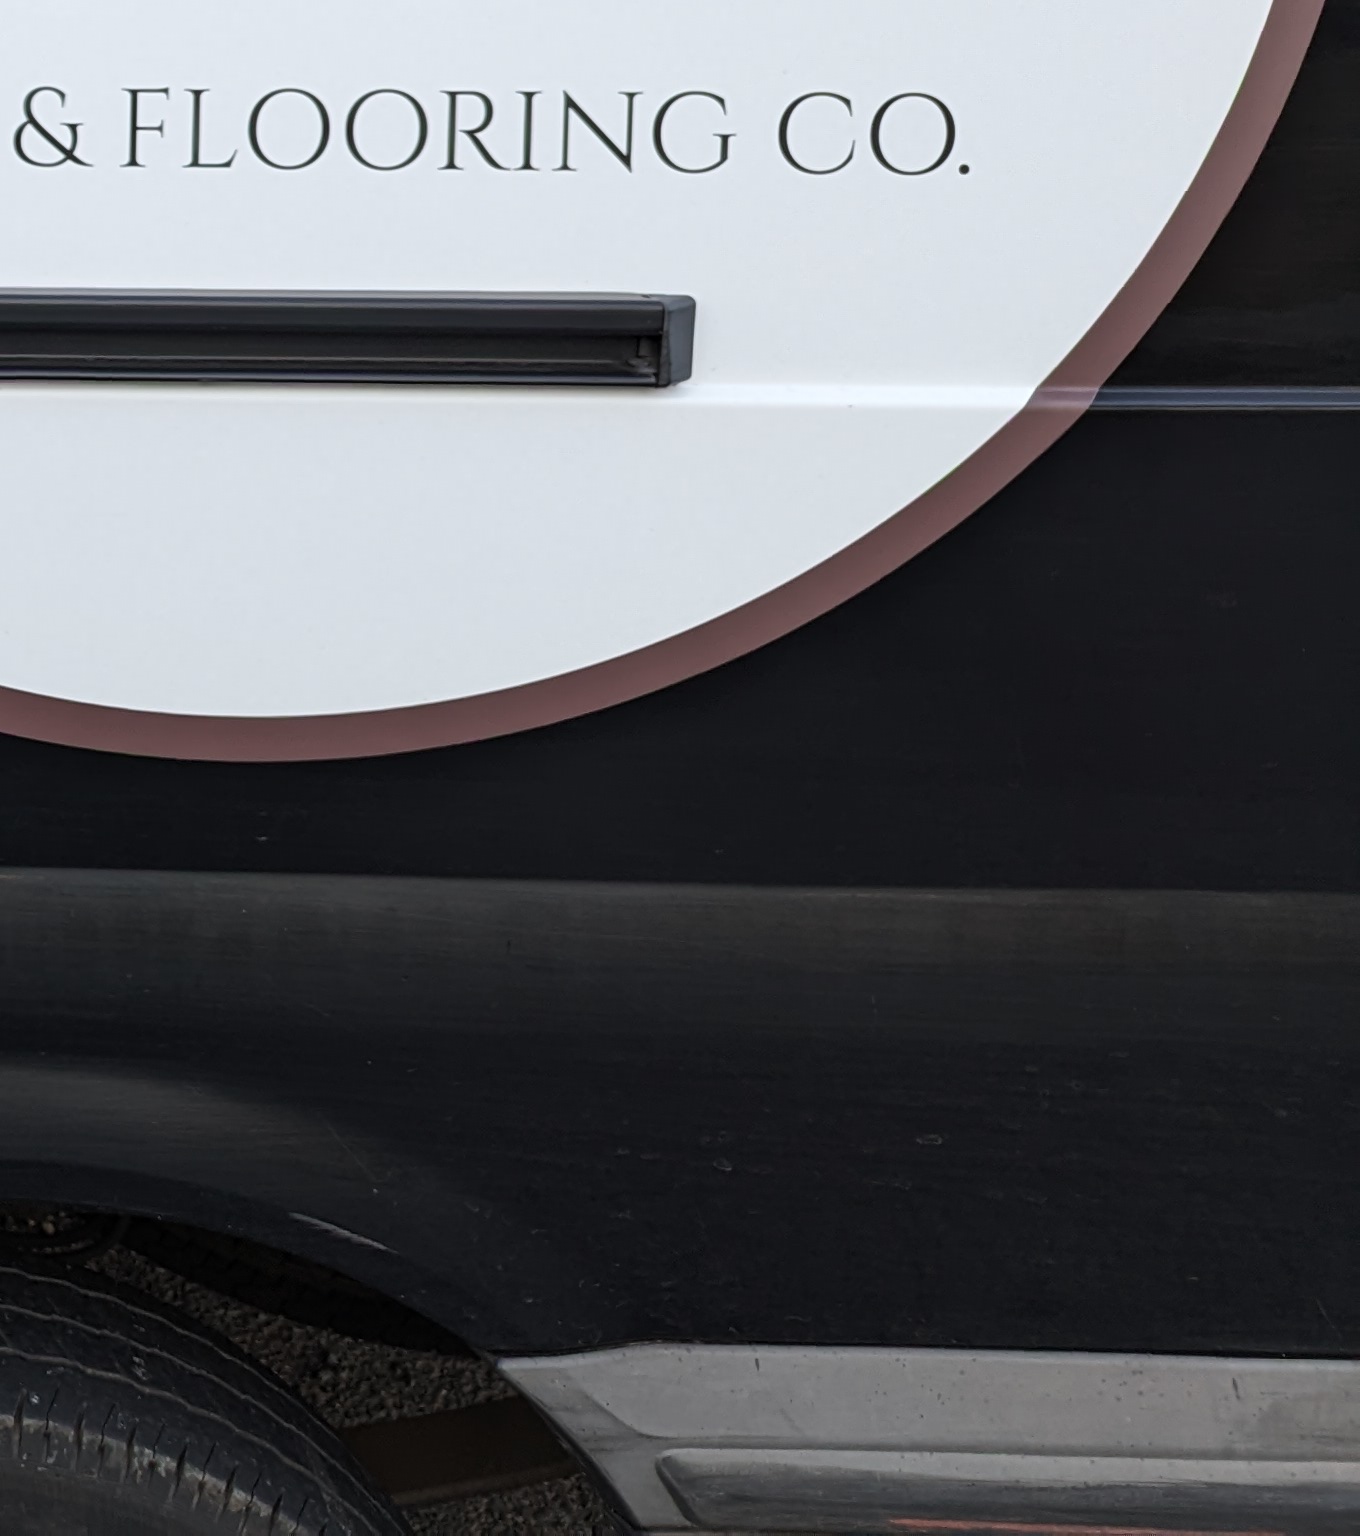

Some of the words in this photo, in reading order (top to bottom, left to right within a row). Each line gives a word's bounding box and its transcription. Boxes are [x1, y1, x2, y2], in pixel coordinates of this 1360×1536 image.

[13, 87, 92, 170] &
[120, 86, 735, 177] FLOORING
[778, 91, 974, 179] CO.
